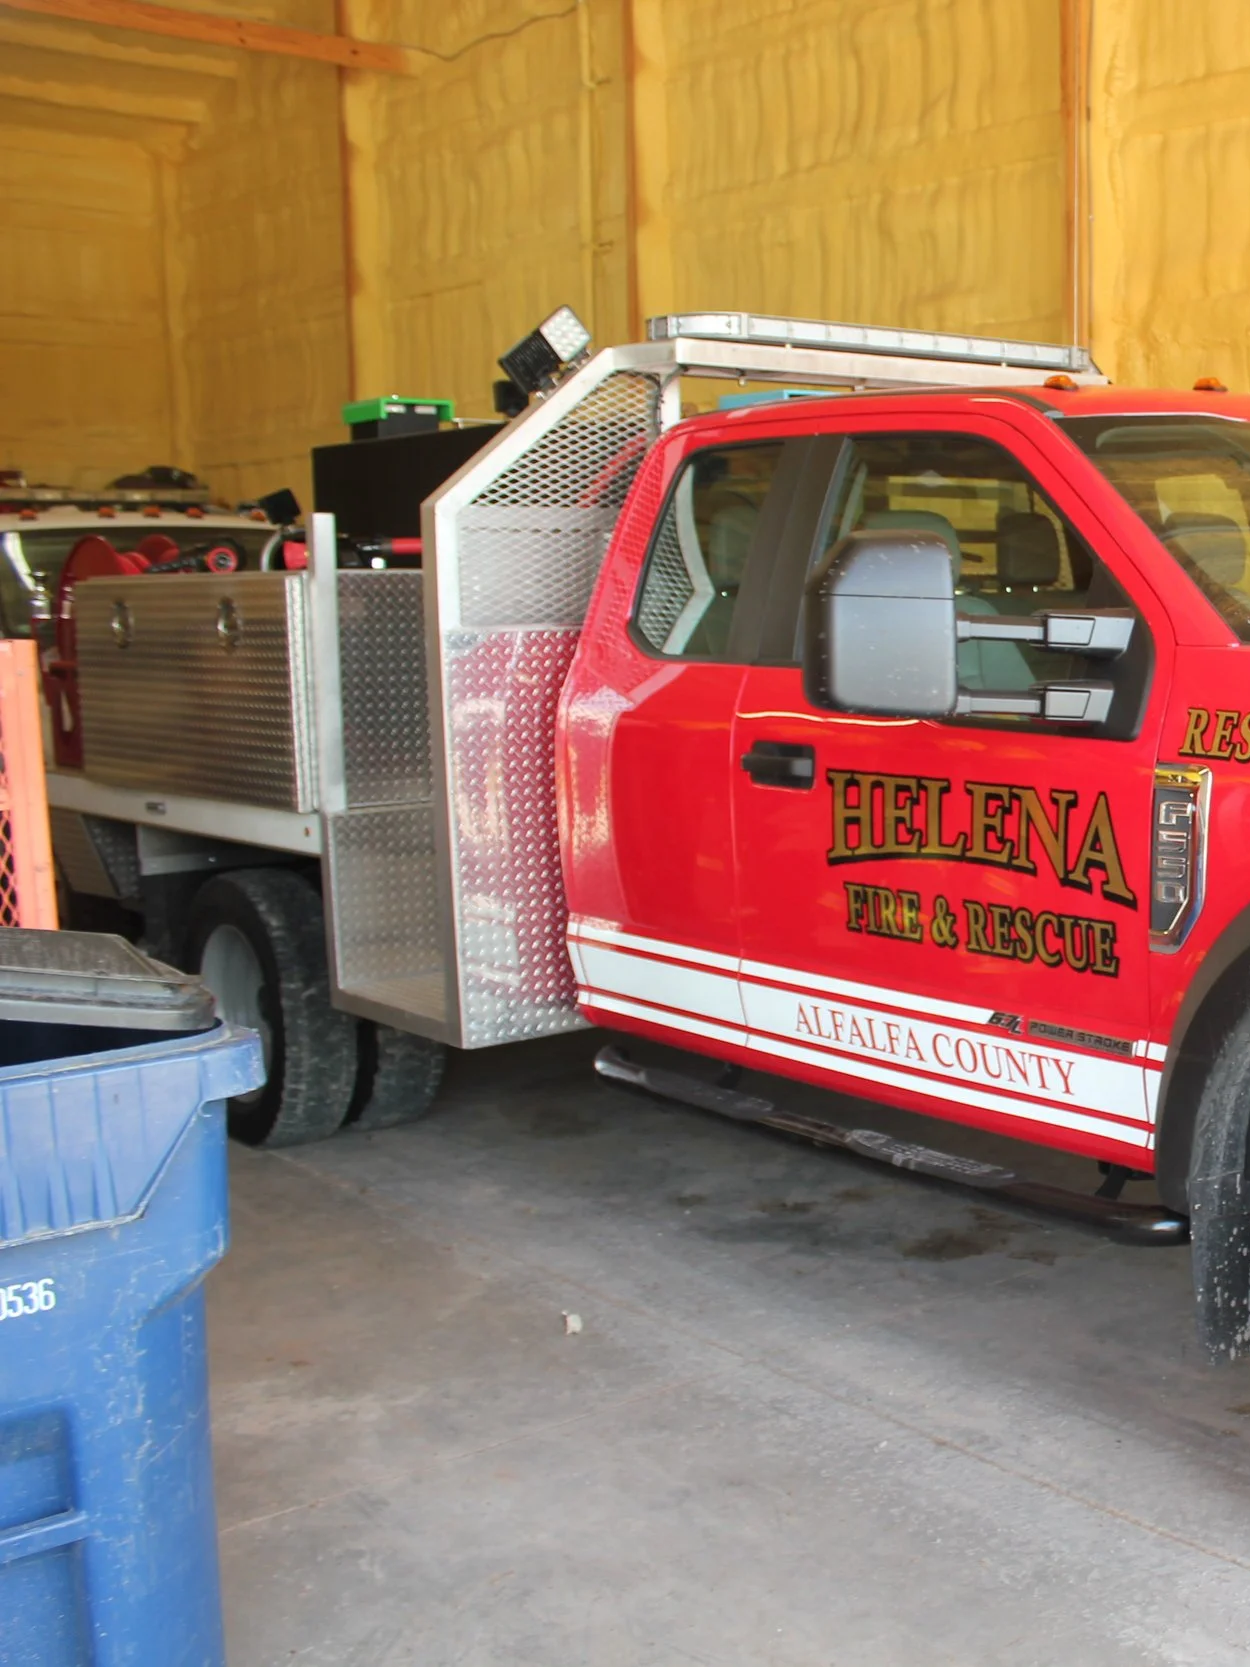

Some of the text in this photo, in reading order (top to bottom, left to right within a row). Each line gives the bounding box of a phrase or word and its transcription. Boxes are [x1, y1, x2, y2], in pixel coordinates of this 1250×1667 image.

[827, 769, 1137, 908] HELENA
[845, 883, 1118, 976] FIRE & RESCUE
[795, 1003, 1075, 1095] ALFALFA COUNTY
[1031, 1022, 1074, 1040] POWER
[1077, 1032, 1130, 1052] STROKE
